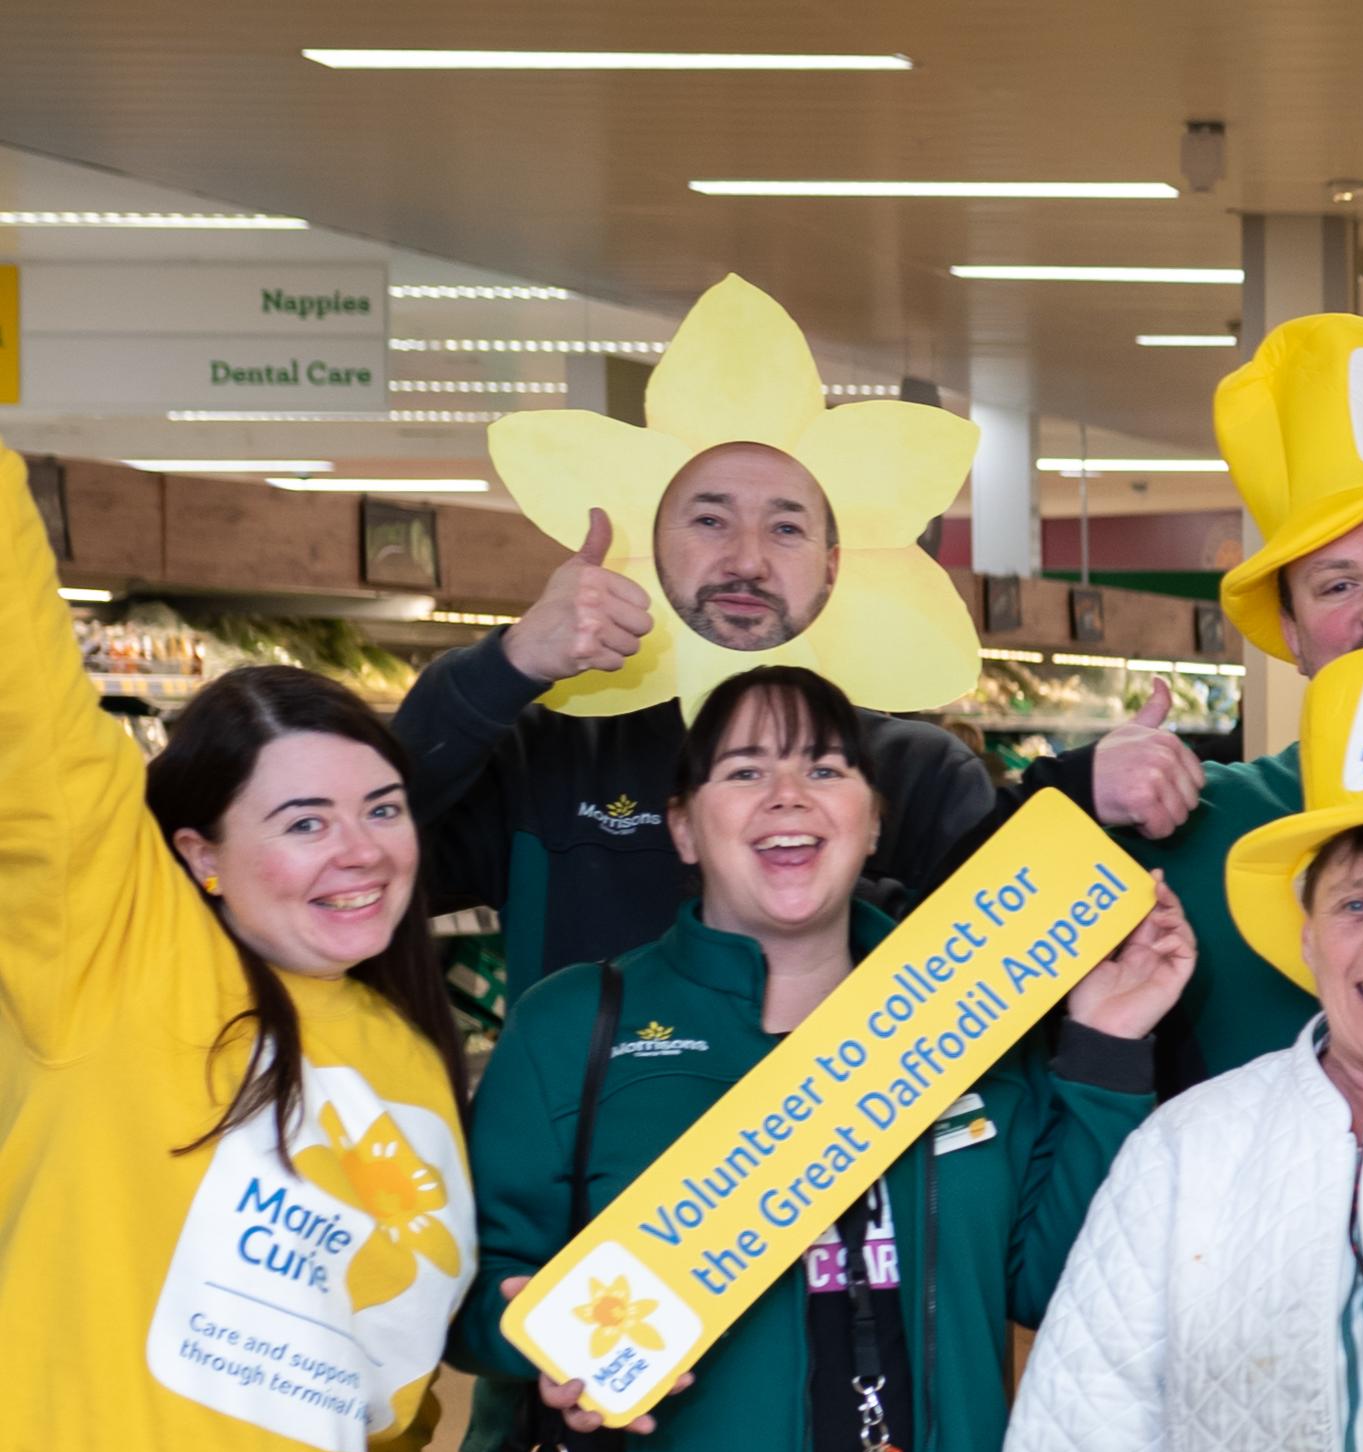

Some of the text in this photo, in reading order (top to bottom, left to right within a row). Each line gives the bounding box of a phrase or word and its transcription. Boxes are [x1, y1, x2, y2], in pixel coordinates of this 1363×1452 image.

[261, 286, 371, 320] Nappies
[210, 358, 372, 387] Dental Care
[577, 801, 662, 829] Morrisons
[638, 1076, 824, 1247] Volunteer
[814, 1039, 868, 1083] to
[867, 921, 989, 1039] collect
[973, 866, 1039, 927] for
[690, 1229, 768, 1296] the
[758, 1126, 871, 1229] Great
[855, 981, 1010, 1132] Daffodil
[1000, 863, 1129, 995] Appeal
[235, 1176, 353, 1255] Marie
[237, 1225, 331, 1295] Curie
[189, 1311, 241, 1346] Care
[243, 1335, 290, 1362] and
[178, 1338, 268, 1387] through
[592, 1345, 638, 1387] Marie
[609, 1358, 650, 1393] Curie
